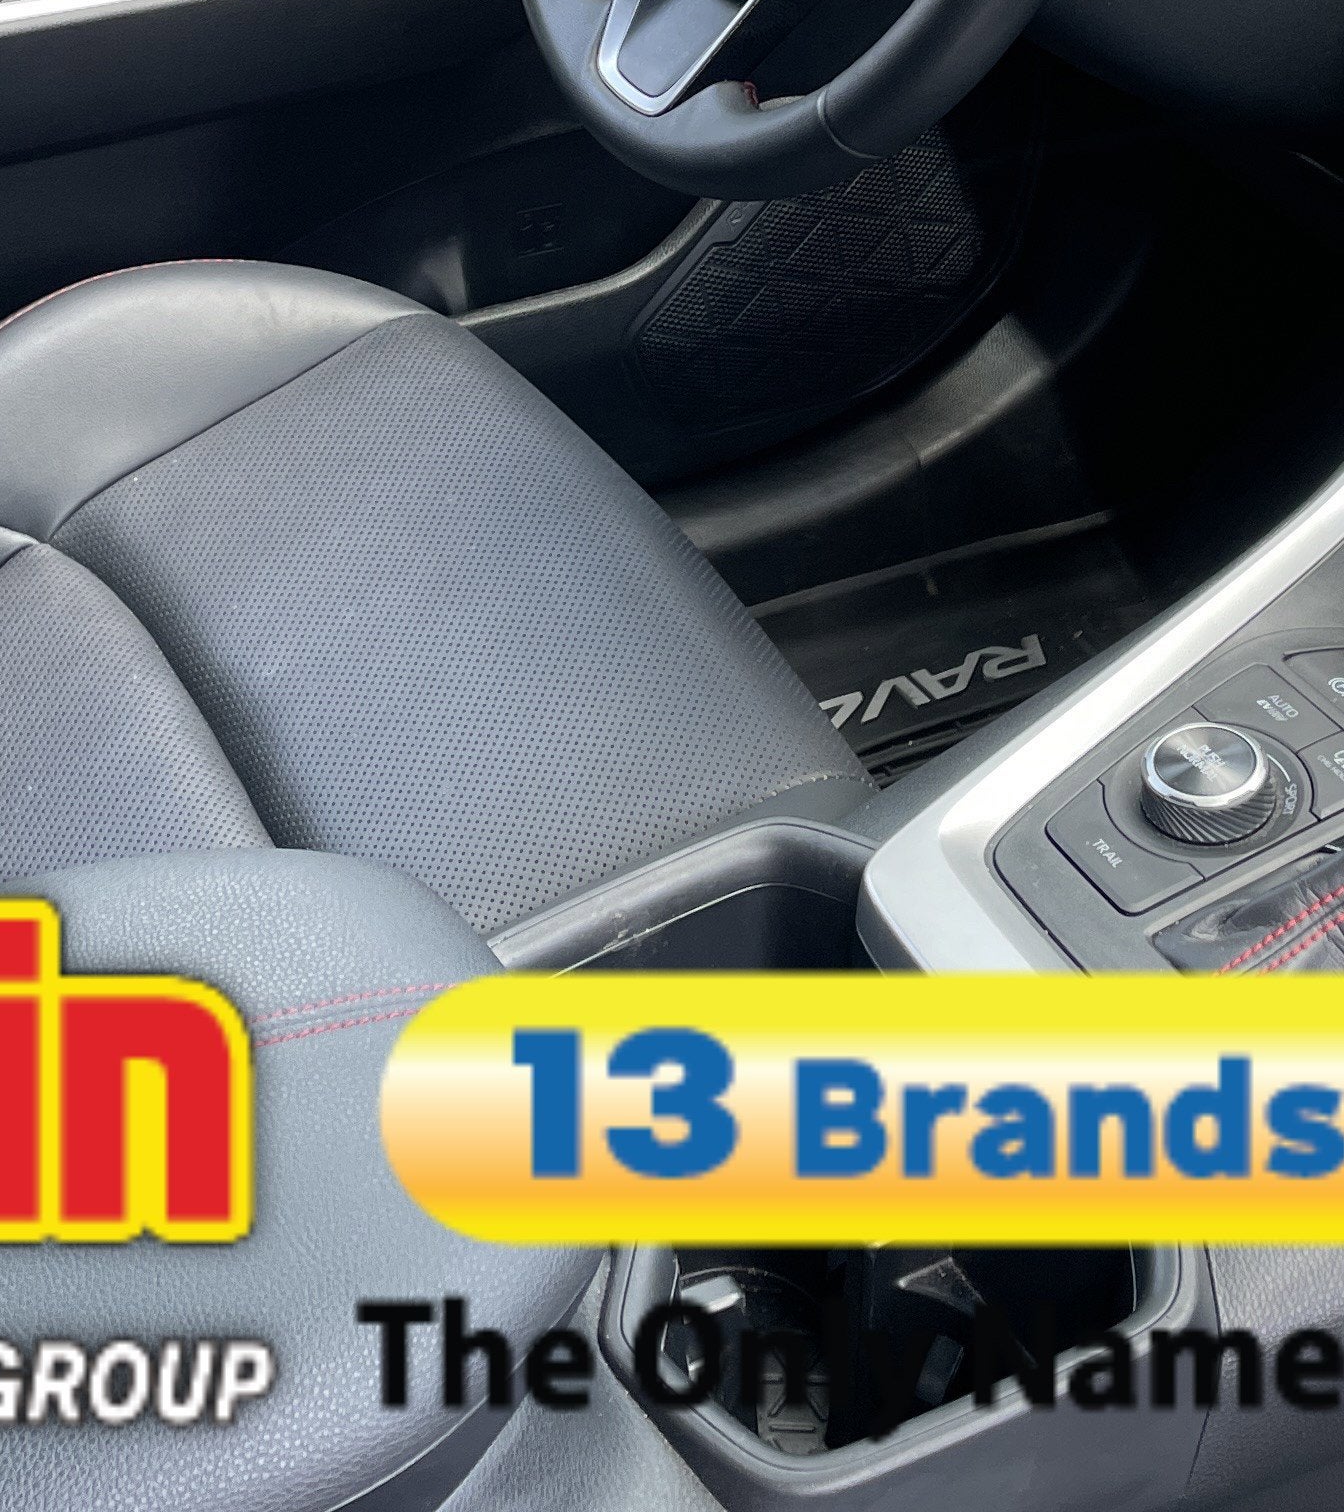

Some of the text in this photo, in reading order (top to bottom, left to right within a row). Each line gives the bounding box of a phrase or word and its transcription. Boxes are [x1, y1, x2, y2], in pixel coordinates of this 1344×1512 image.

[1268, 694, 1299, 719] AUTO
[1283, 782, 1298, 816] SPORT
[1092, 838, 1123, 868] TRAIL
